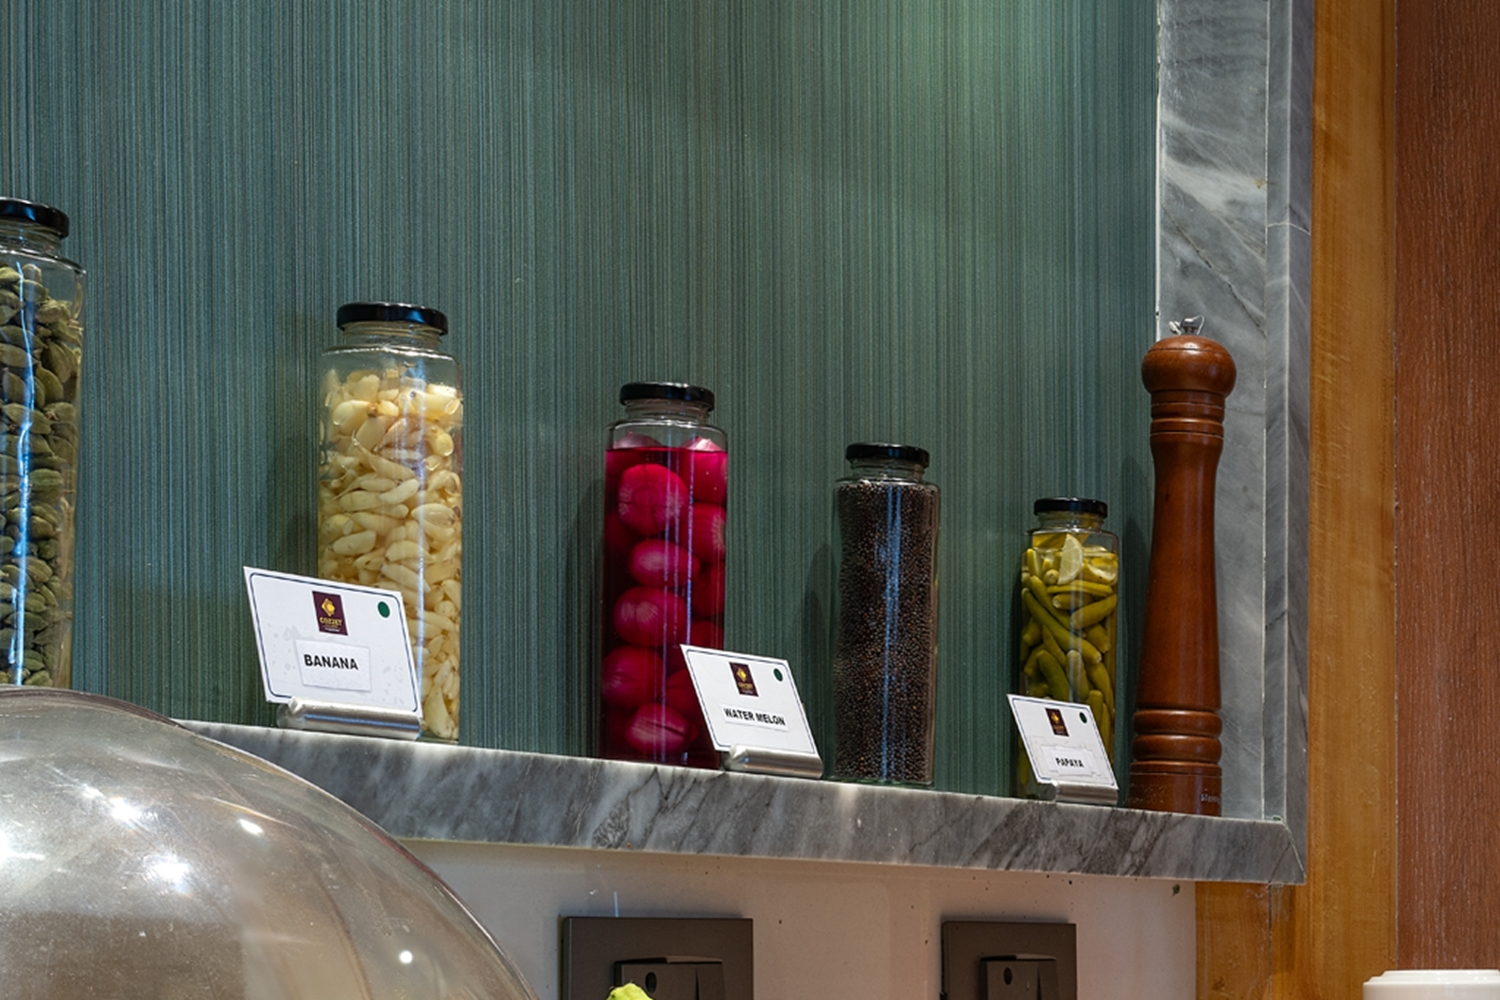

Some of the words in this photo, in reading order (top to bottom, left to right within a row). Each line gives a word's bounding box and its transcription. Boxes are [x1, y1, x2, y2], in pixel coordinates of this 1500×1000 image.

[303, 653, 359, 670] BANANA
[723, 707, 755, 721] WATER
[755, 712, 786, 726] MELON
[1055, 757, 1085, 768] PAPAYA
